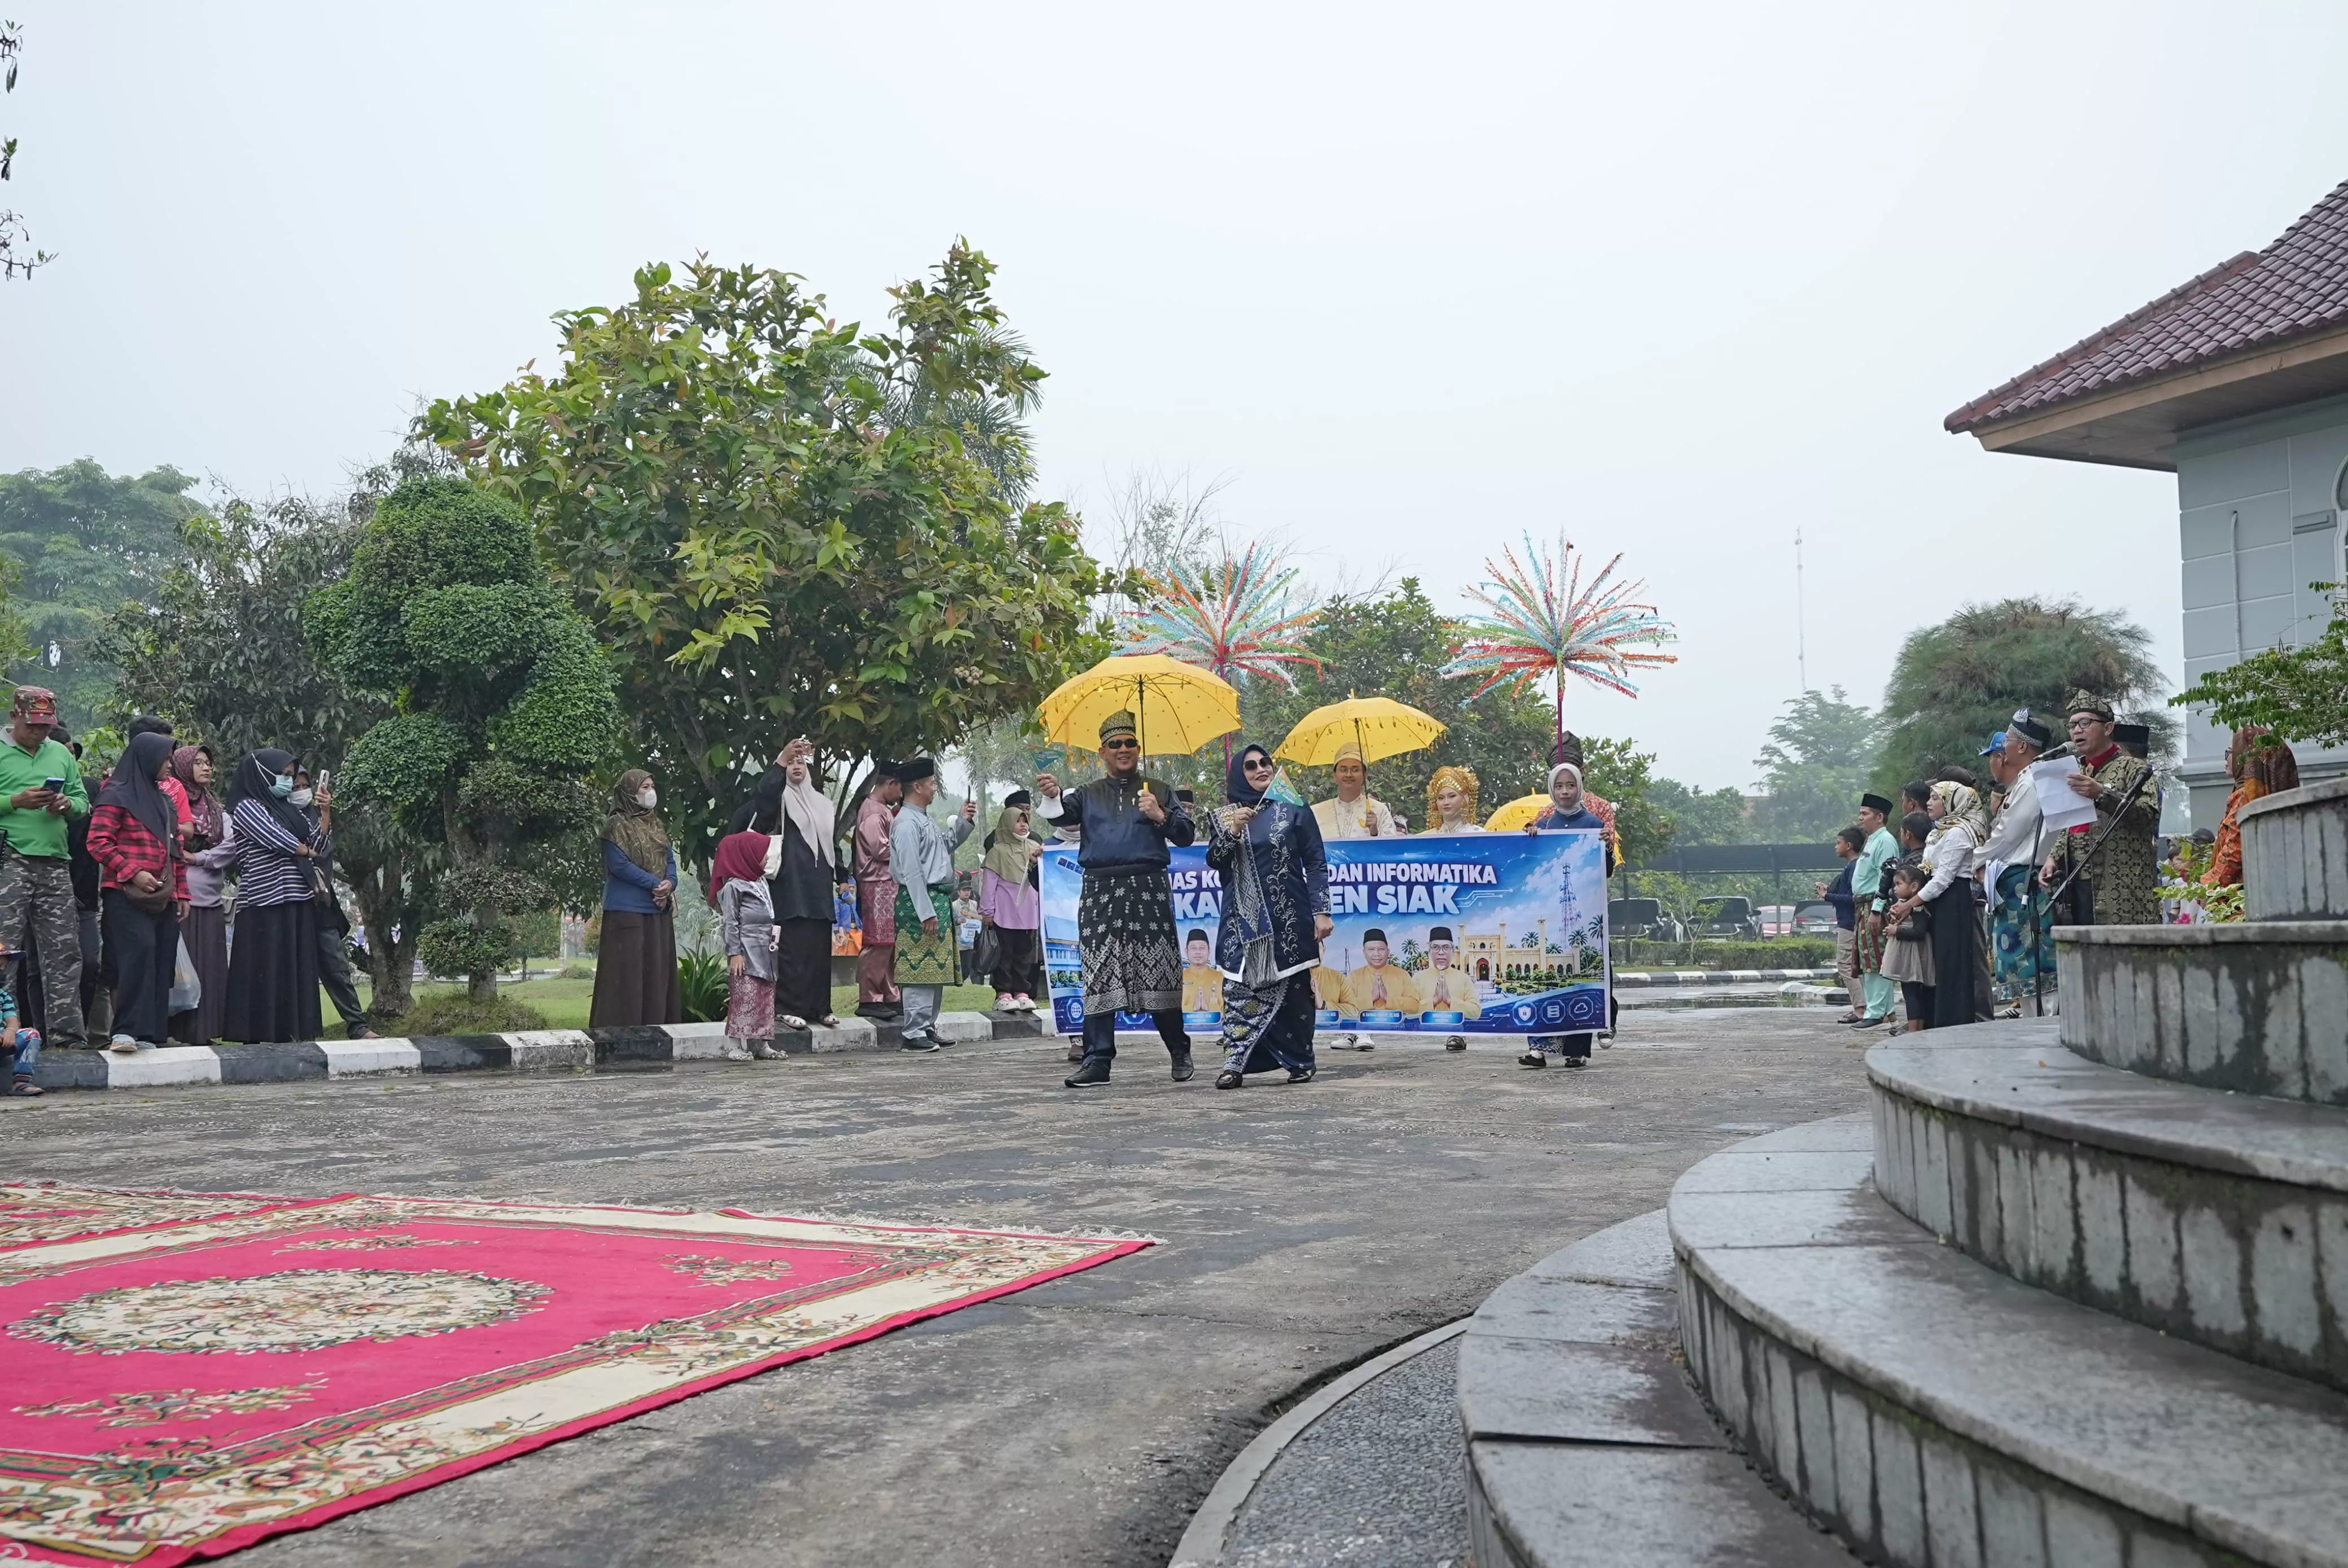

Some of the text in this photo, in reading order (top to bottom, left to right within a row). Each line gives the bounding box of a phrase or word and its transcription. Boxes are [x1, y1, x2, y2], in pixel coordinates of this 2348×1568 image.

[1327, 863, 1363, 883] DAN
[1367, 863, 1497, 884] INFORMATIKA
[1376, 884, 1461, 914] SIAK
